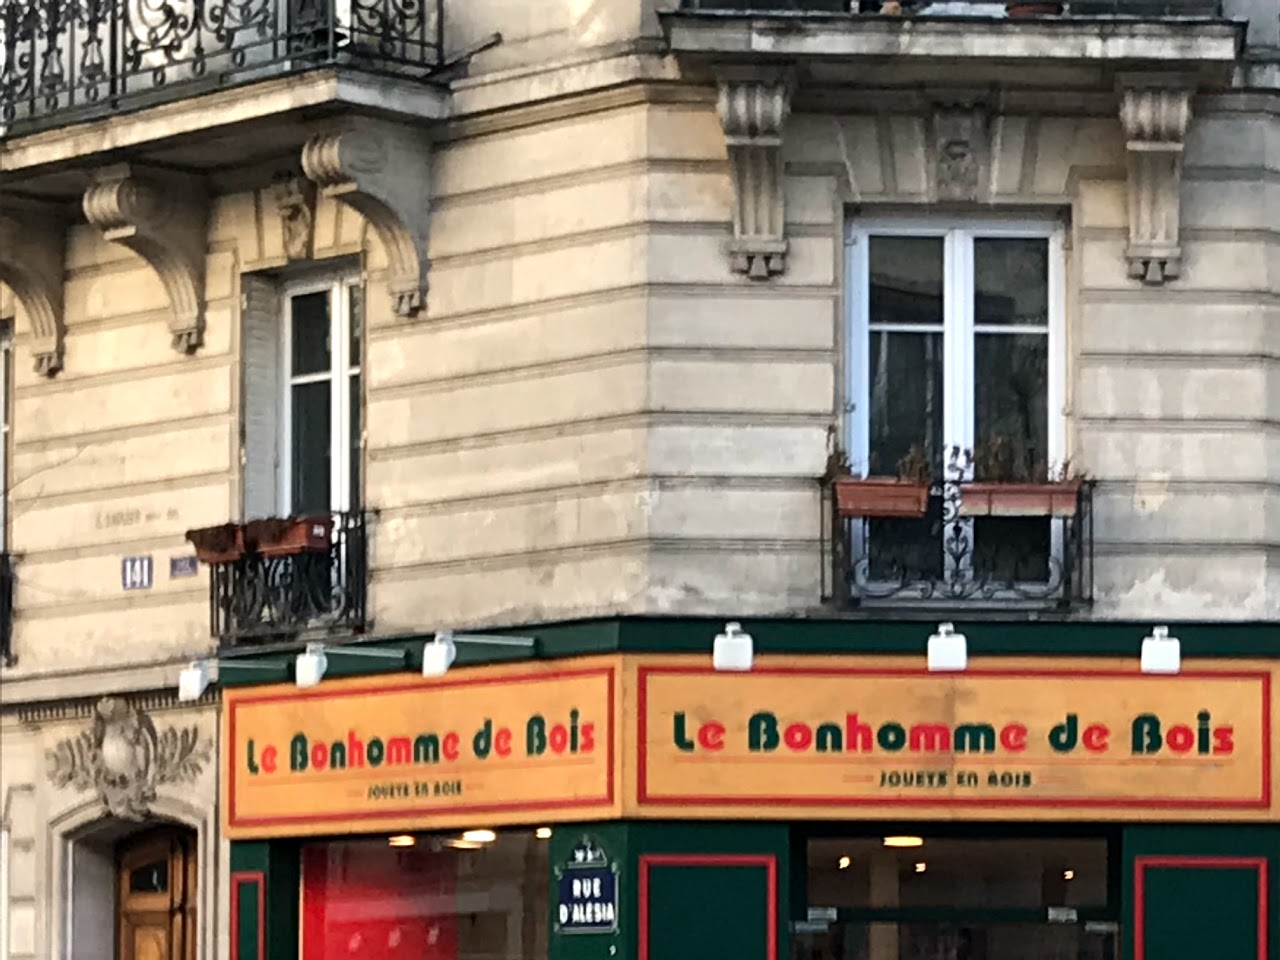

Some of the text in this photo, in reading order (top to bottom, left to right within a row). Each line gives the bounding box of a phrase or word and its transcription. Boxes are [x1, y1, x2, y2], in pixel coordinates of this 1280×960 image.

[125, 559, 148, 588] 141
[247, 708, 595, 775] Le Bonhomme de Bois
[673, 708, 1235, 756] Le Bonhomme de Bois
[880, 770, 947, 788] JOUETS
[988, 771, 1032, 788] BOIS
[572, 877, 602, 899] RUE
